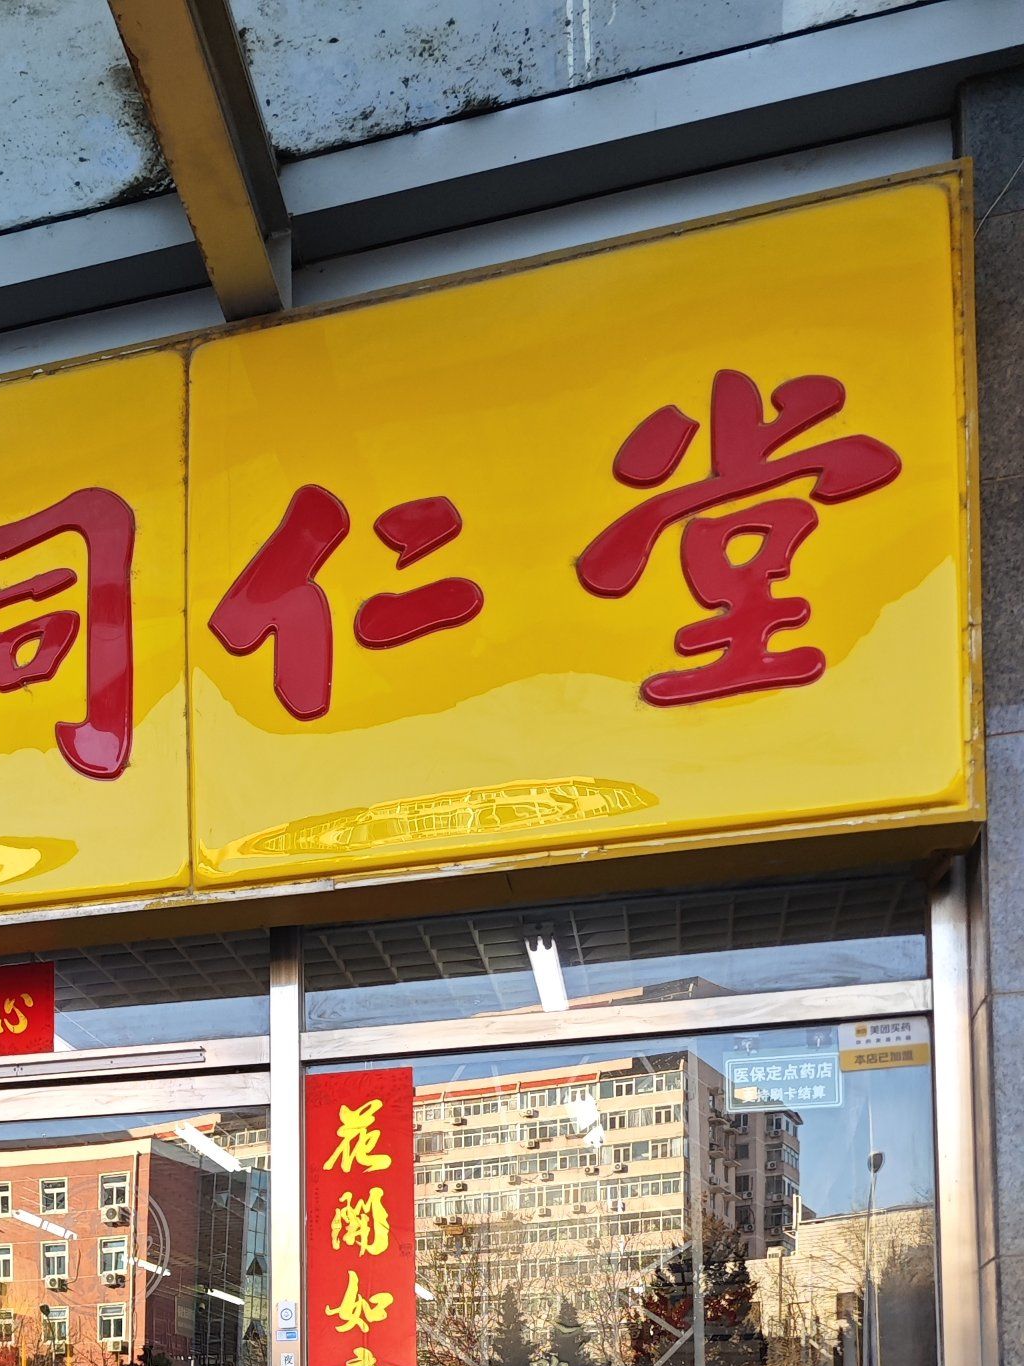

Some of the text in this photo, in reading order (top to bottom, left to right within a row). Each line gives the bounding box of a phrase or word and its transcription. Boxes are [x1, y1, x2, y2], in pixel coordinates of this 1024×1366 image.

[733, 1062, 833, 1083] 医保定点药店
